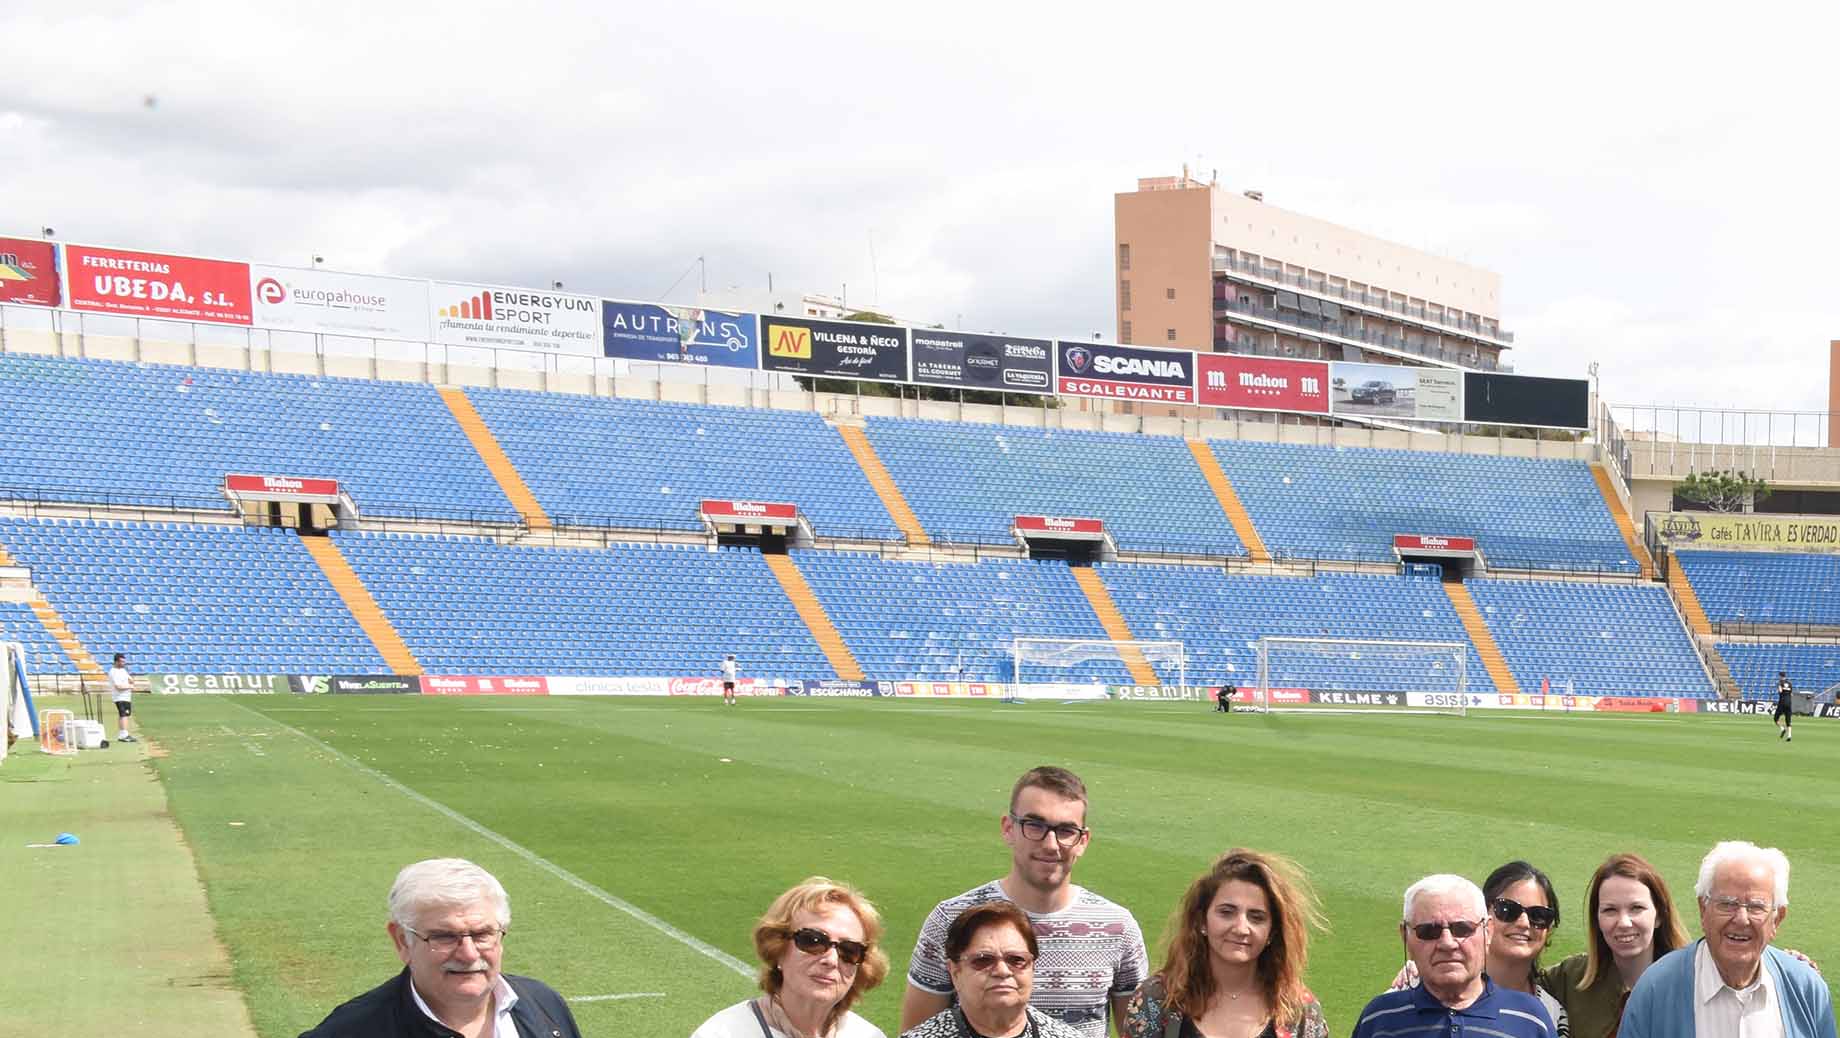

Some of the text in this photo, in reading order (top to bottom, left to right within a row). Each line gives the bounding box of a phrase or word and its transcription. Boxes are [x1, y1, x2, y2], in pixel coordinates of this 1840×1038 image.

[83, 256, 170, 274] FERRETERIAS
[203, 291, 234, 307] S.L.
[293, 288, 385, 307] europahouse
[493, 292, 594, 312] ENERGYUM
[495, 309, 551, 324] SPORT
[613, 313, 731, 338] AUTRNS
[814, 331, 899, 347] VILLENA & ÑECO
[837, 345, 877, 356] GESTORÍA
[1093, 355, 1185, 379] SCANIA
[1239, 372, 1288, 390] Mahou
[1066, 381, 1186, 400] SCALEVANTE
[1711, 527, 1732, 541] Cafés
[1787, 524, 1797, 542] ES
[1800, 525, 1836, 543] VERDAD
[163, 674, 277, 694] geamur
[1319, 692, 1382, 704] KELME
[1424, 694, 1469, 706] asisa
